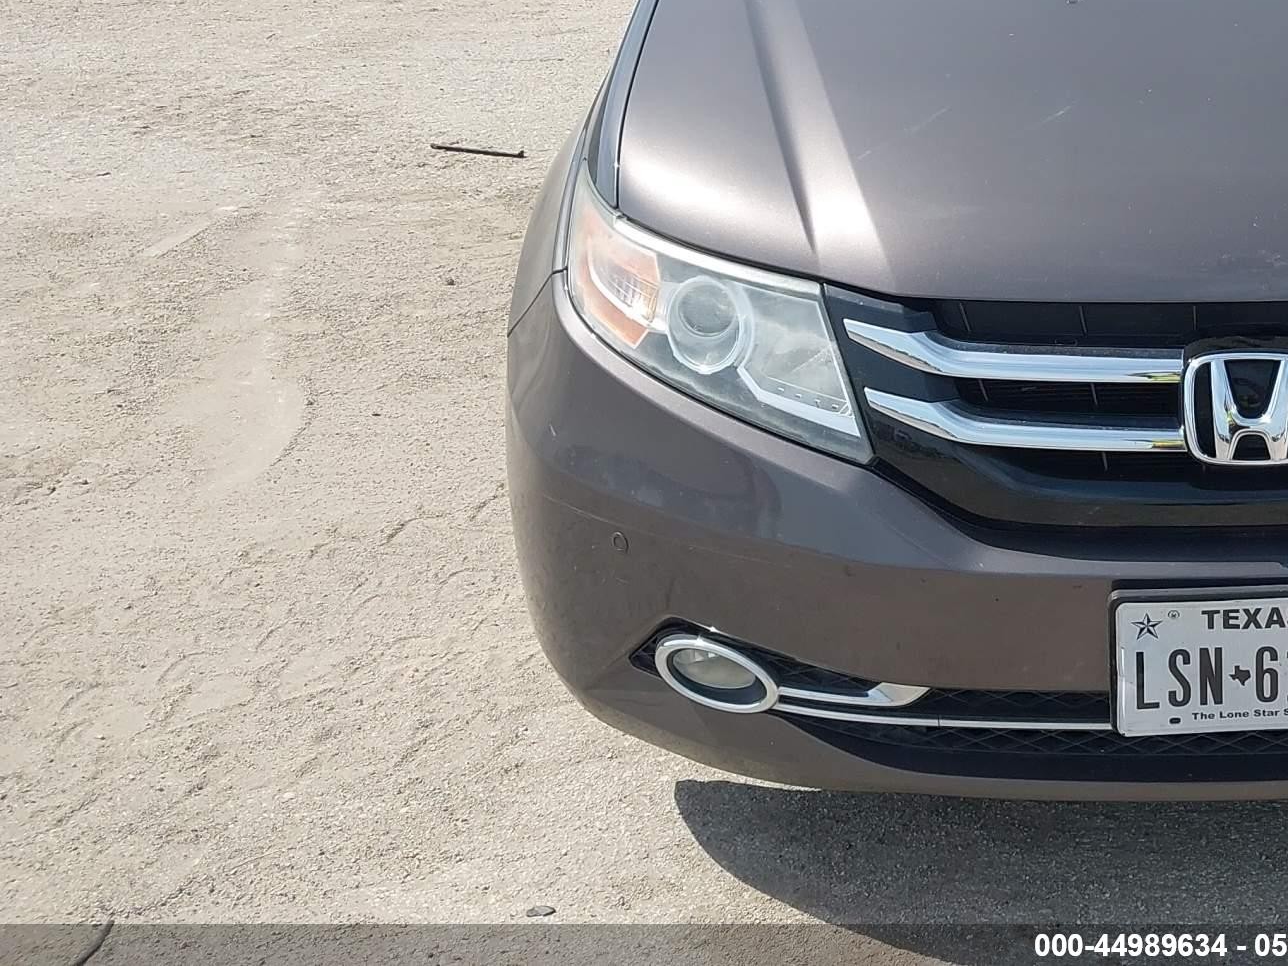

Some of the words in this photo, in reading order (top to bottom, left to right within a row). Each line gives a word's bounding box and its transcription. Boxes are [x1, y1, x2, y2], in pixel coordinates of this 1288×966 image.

[1192, 712, 1215, 721] The
[1219, 710, 1250, 720] Lone
[1253, 709, 1280, 718] Star
